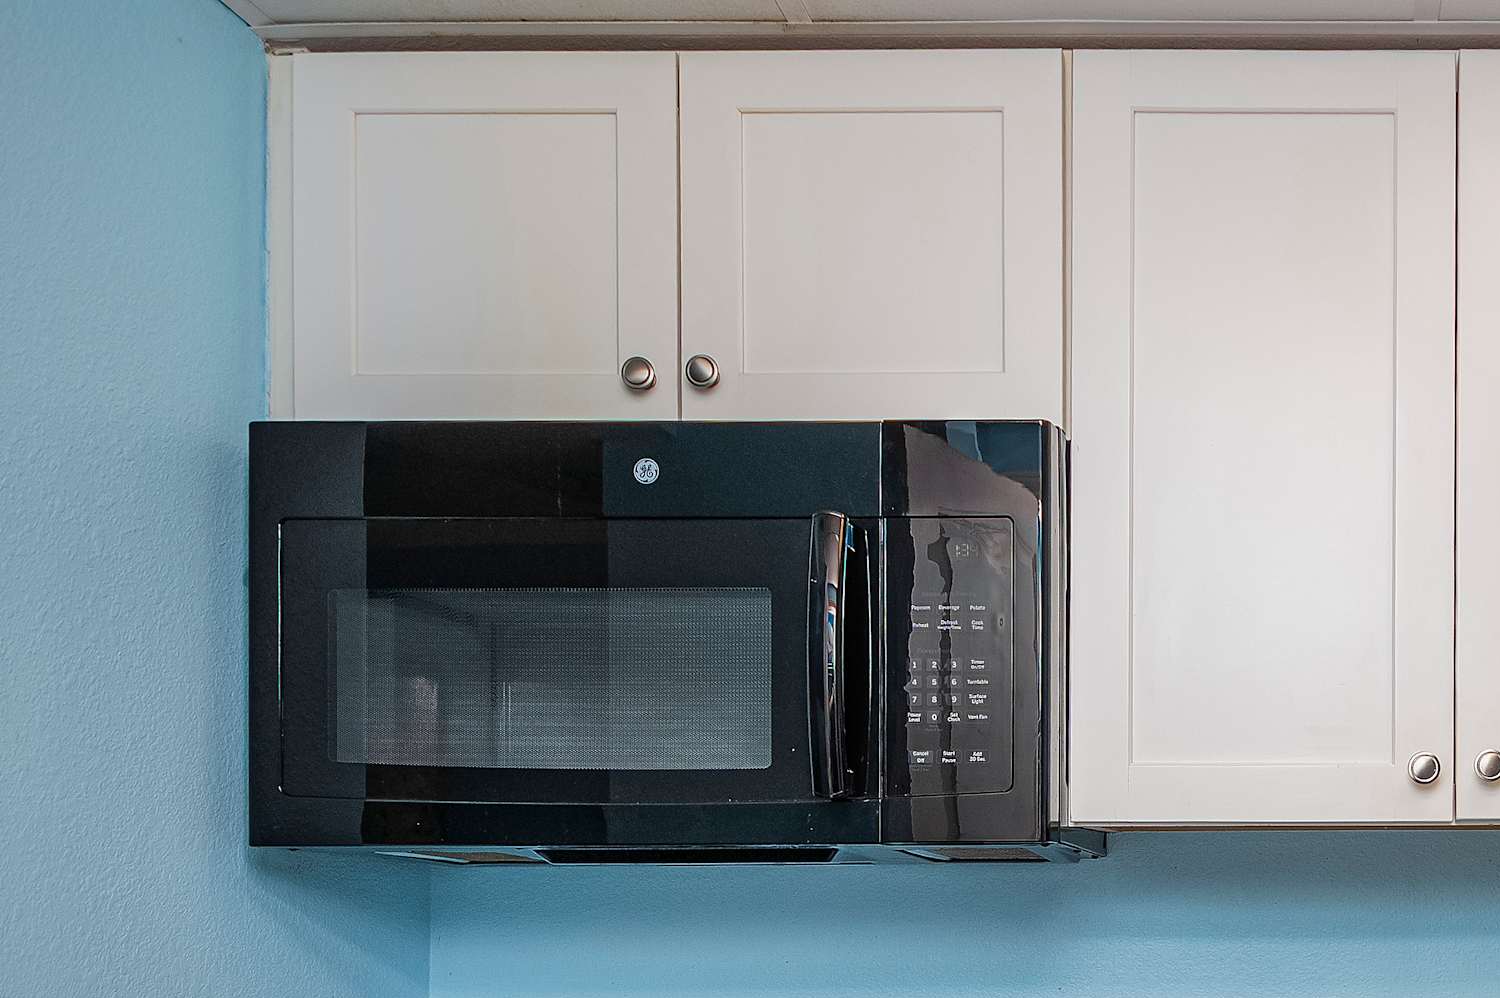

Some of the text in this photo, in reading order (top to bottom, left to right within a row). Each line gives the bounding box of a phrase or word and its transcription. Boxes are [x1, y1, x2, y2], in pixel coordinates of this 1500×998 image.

[912, 661, 917, 669] 1
[931, 661, 938, 669] 2
[951, 661, 957, 669] 3
[931, 713, 938, 721] 0
